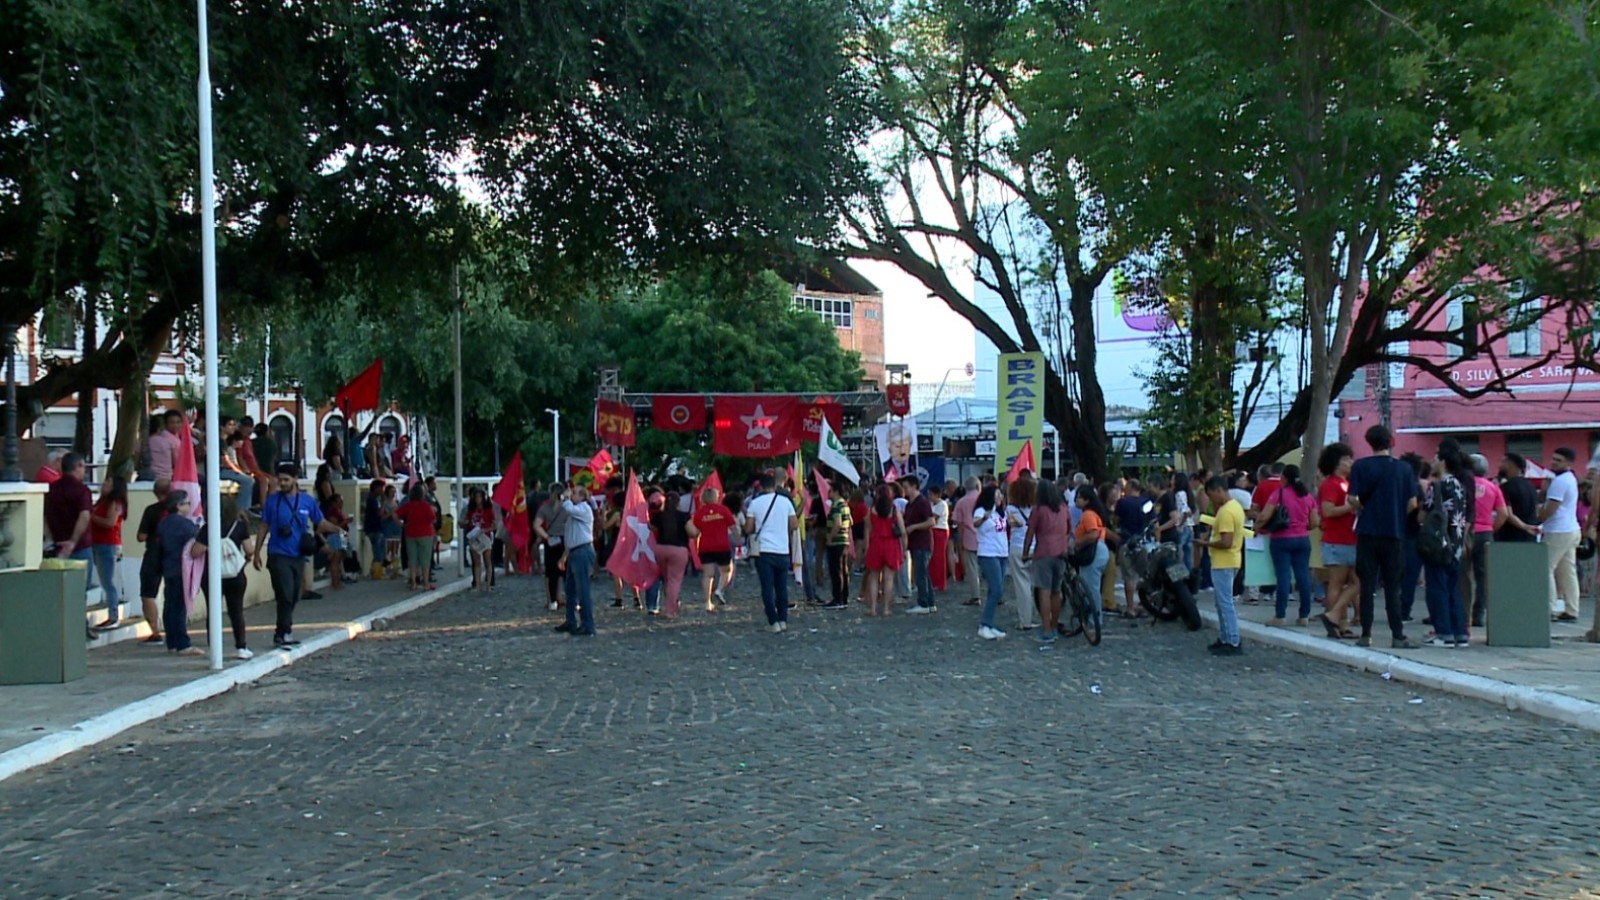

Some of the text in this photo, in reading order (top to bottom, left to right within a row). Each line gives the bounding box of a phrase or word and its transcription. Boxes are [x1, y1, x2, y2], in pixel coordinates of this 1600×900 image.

[1467, 367, 1533, 381] SILVSTE
[1539, 365, 1595, 377] SARAVA
[1006, 359, 1036, 440] BRASIL
